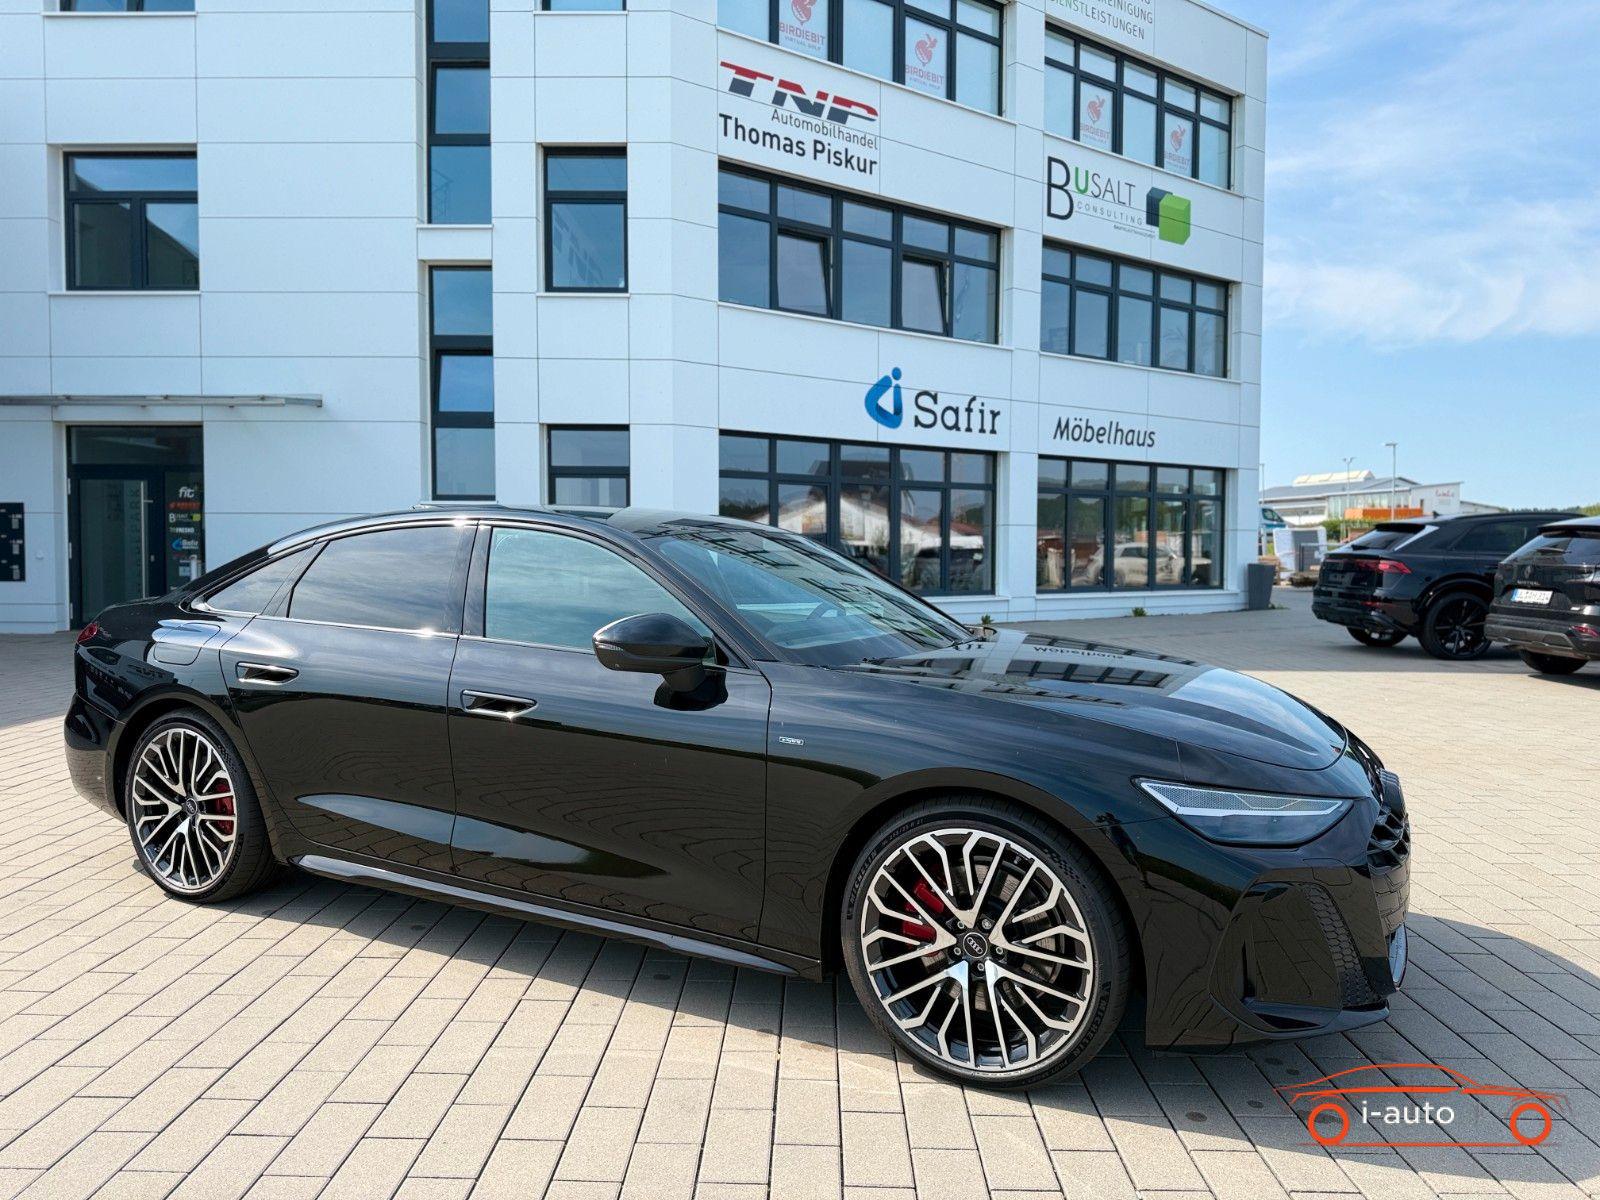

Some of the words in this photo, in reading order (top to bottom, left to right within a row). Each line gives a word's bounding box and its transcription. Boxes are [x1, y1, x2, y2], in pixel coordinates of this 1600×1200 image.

[779, 21, 826, 46] BIRDIEBIT
[720, 61, 878, 124] TNP
[905, 64, 944, 85] BIRDIEBIT
[718, 113, 806, 157] Thomas
[813, 139, 878, 176] Piskur
[771, 108, 878, 150] Automobilhandel
[1047, 156, 1135, 221] BUSALT
[1076, 200, 1143, 225] CONSULTING
[914, 390, 1001, 435] Safir
[1053, 416, 1156, 448] Möbelhaus
